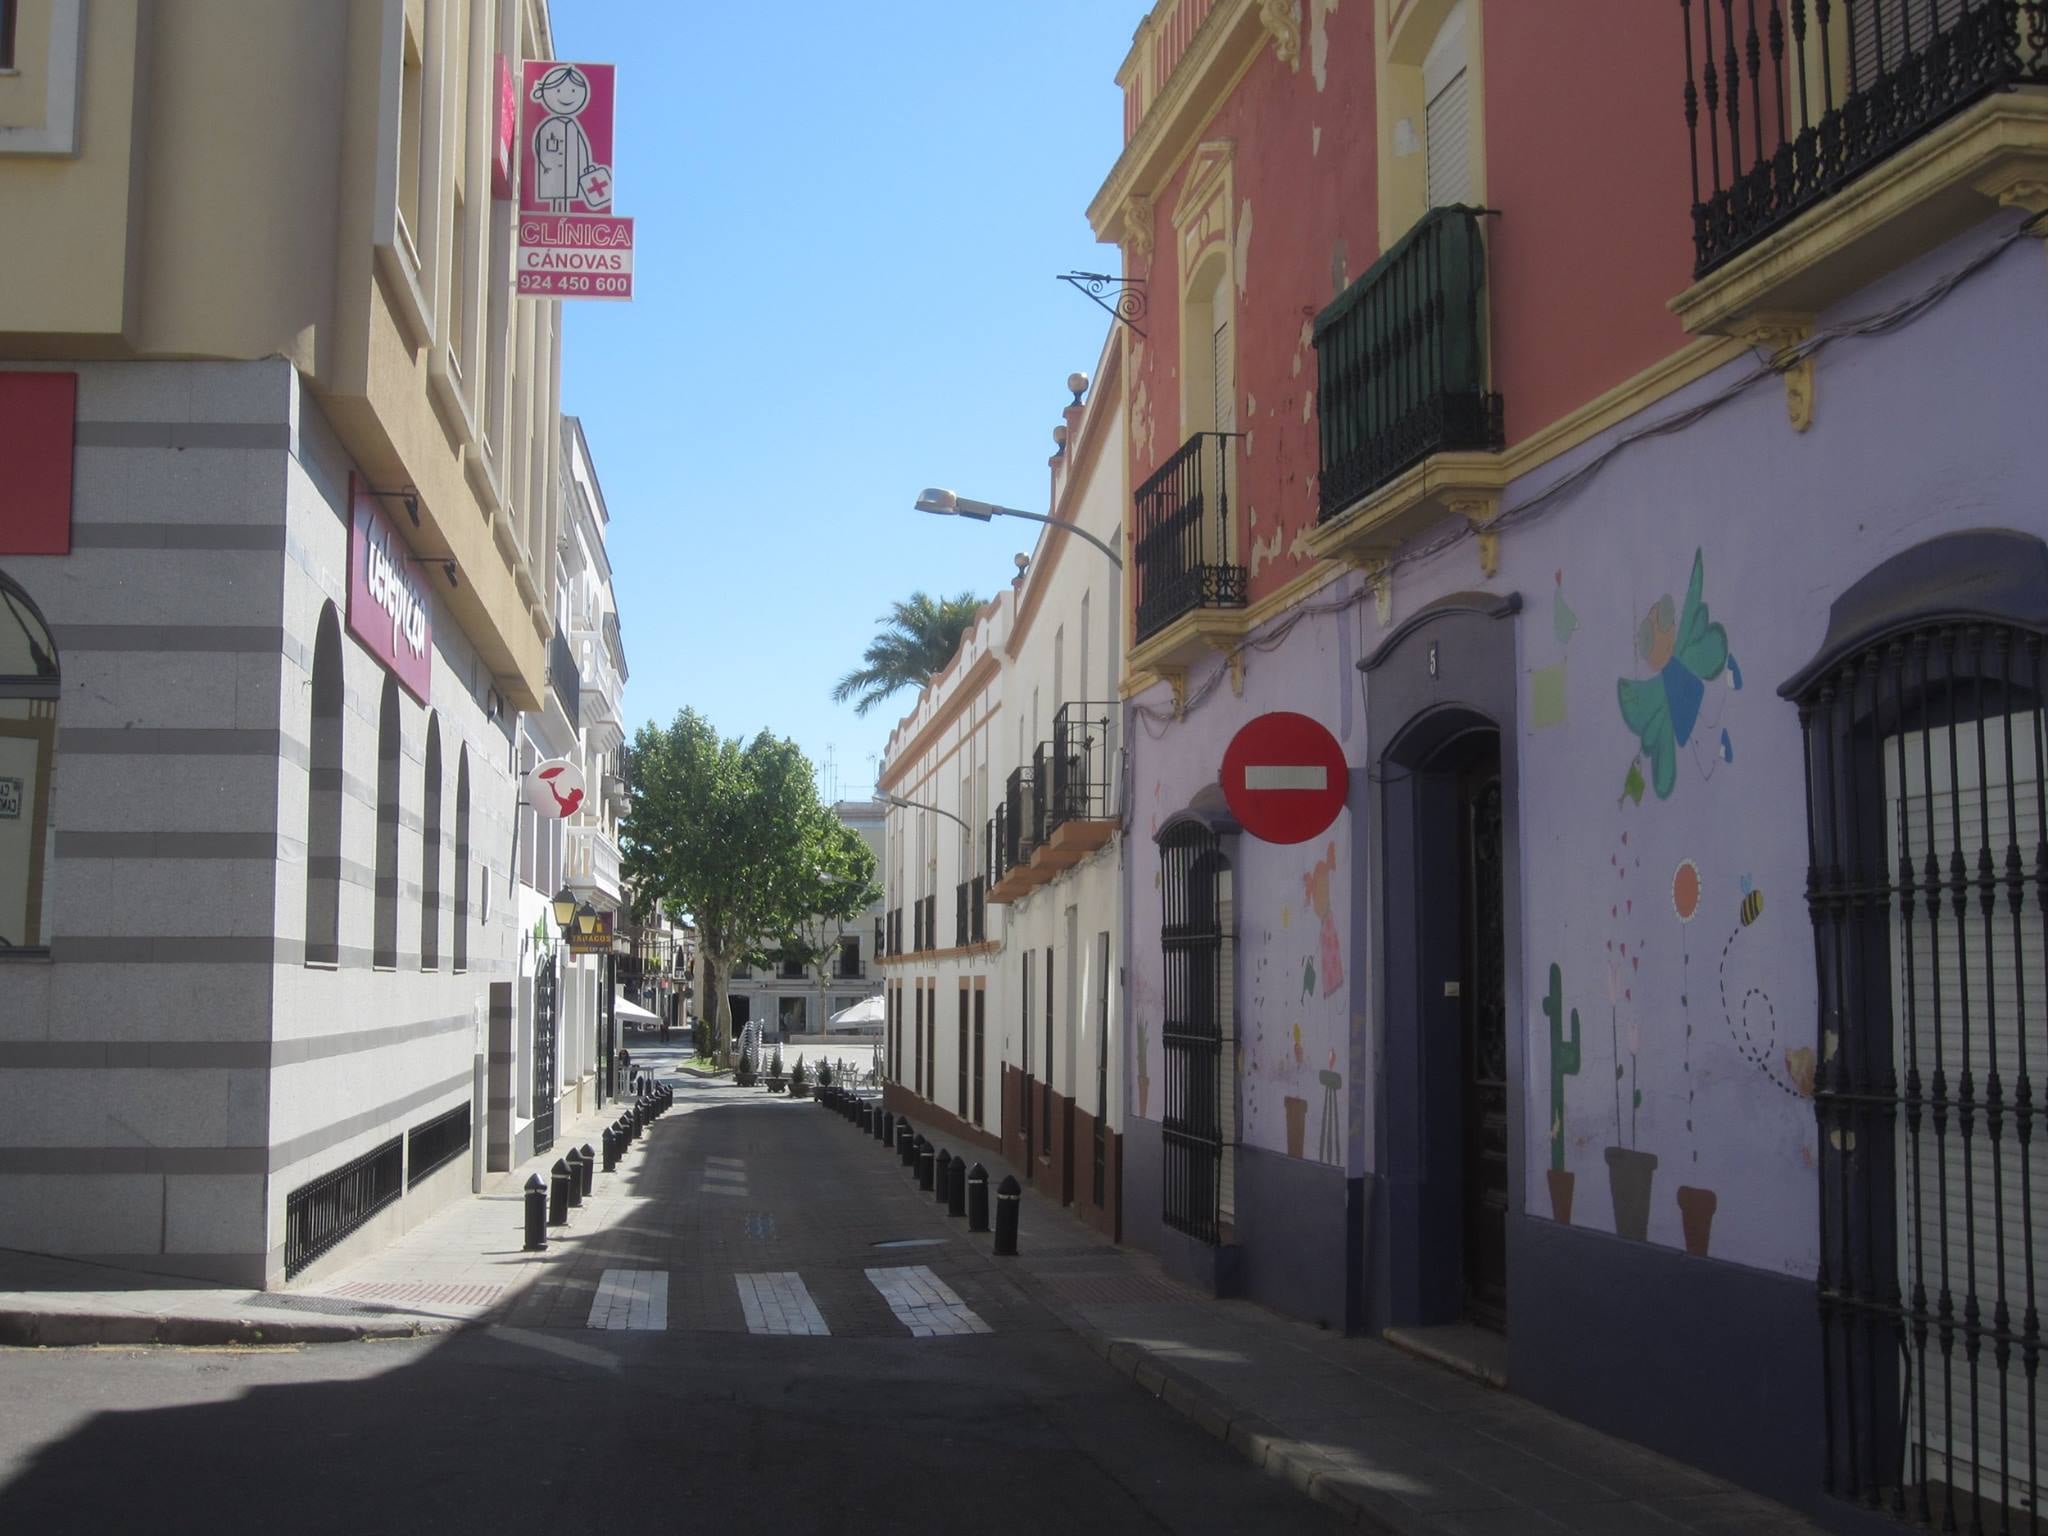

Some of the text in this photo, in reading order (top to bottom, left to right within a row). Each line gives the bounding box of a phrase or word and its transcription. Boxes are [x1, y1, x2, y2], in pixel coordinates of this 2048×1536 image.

[520, 217, 631, 246] CLÍNICA
[527, 249, 622, 270] CÁNOVAS
[520, 275, 627, 292] 924 450 600
[367, 513, 426, 660] telepizza
[1429, 648, 1437, 675] 5
